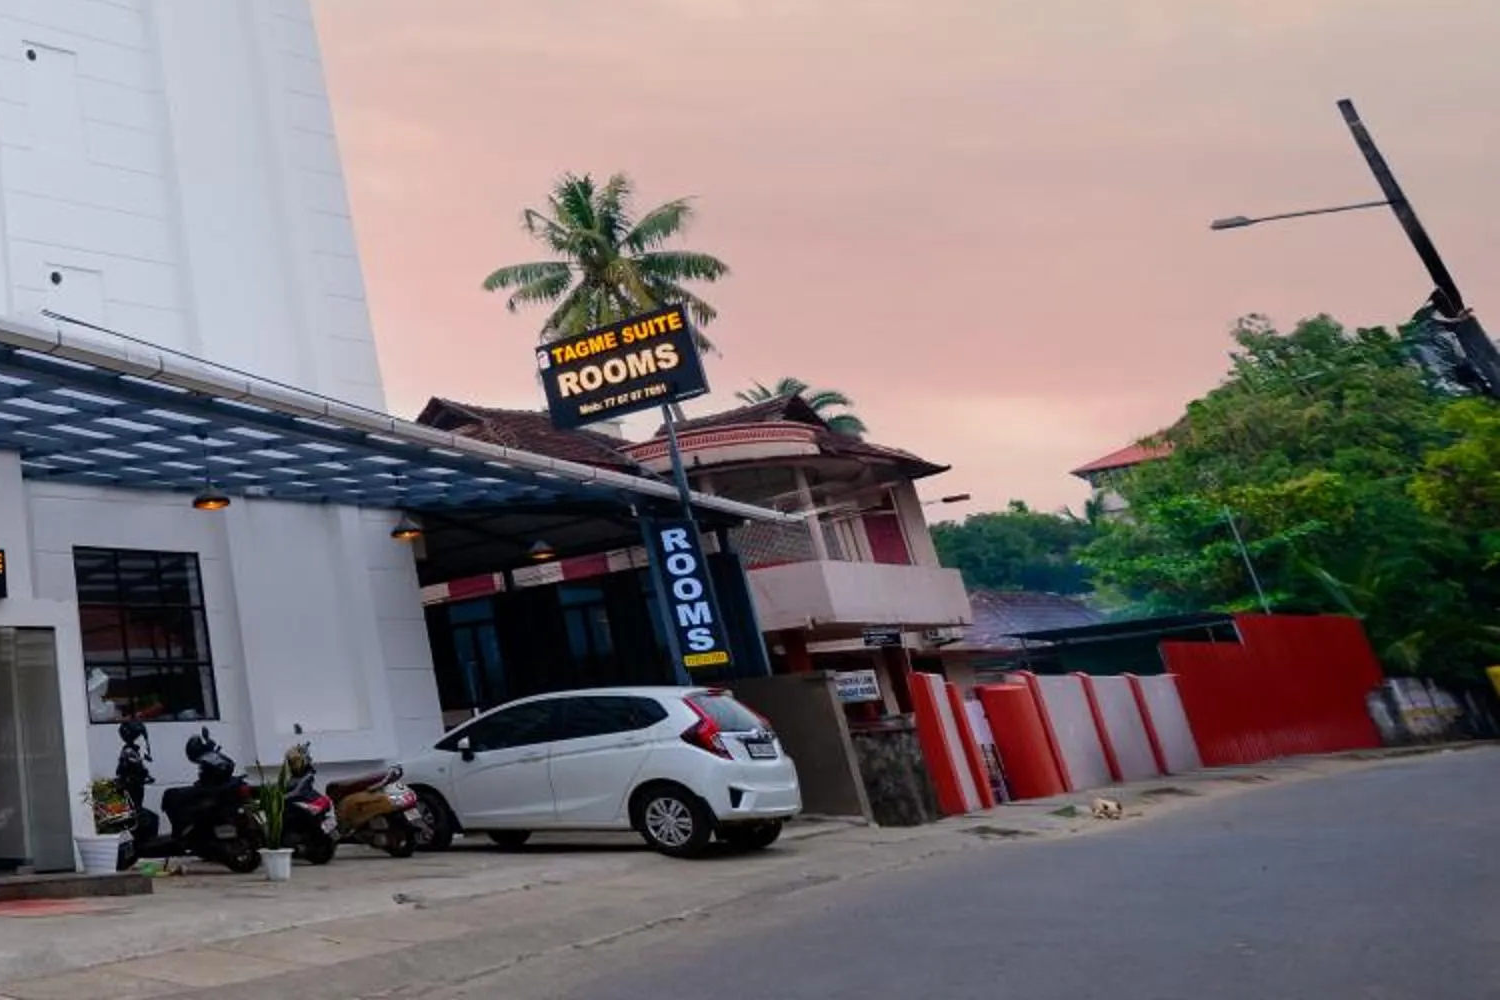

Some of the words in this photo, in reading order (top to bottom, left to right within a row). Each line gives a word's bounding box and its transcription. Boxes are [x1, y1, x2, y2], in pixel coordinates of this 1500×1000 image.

[552, 331, 618, 364] TAGME
[621, 311, 683, 344] SUITE
[557, 343, 680, 398] ROOMS
[660, 527, 715, 651] ROOMS
